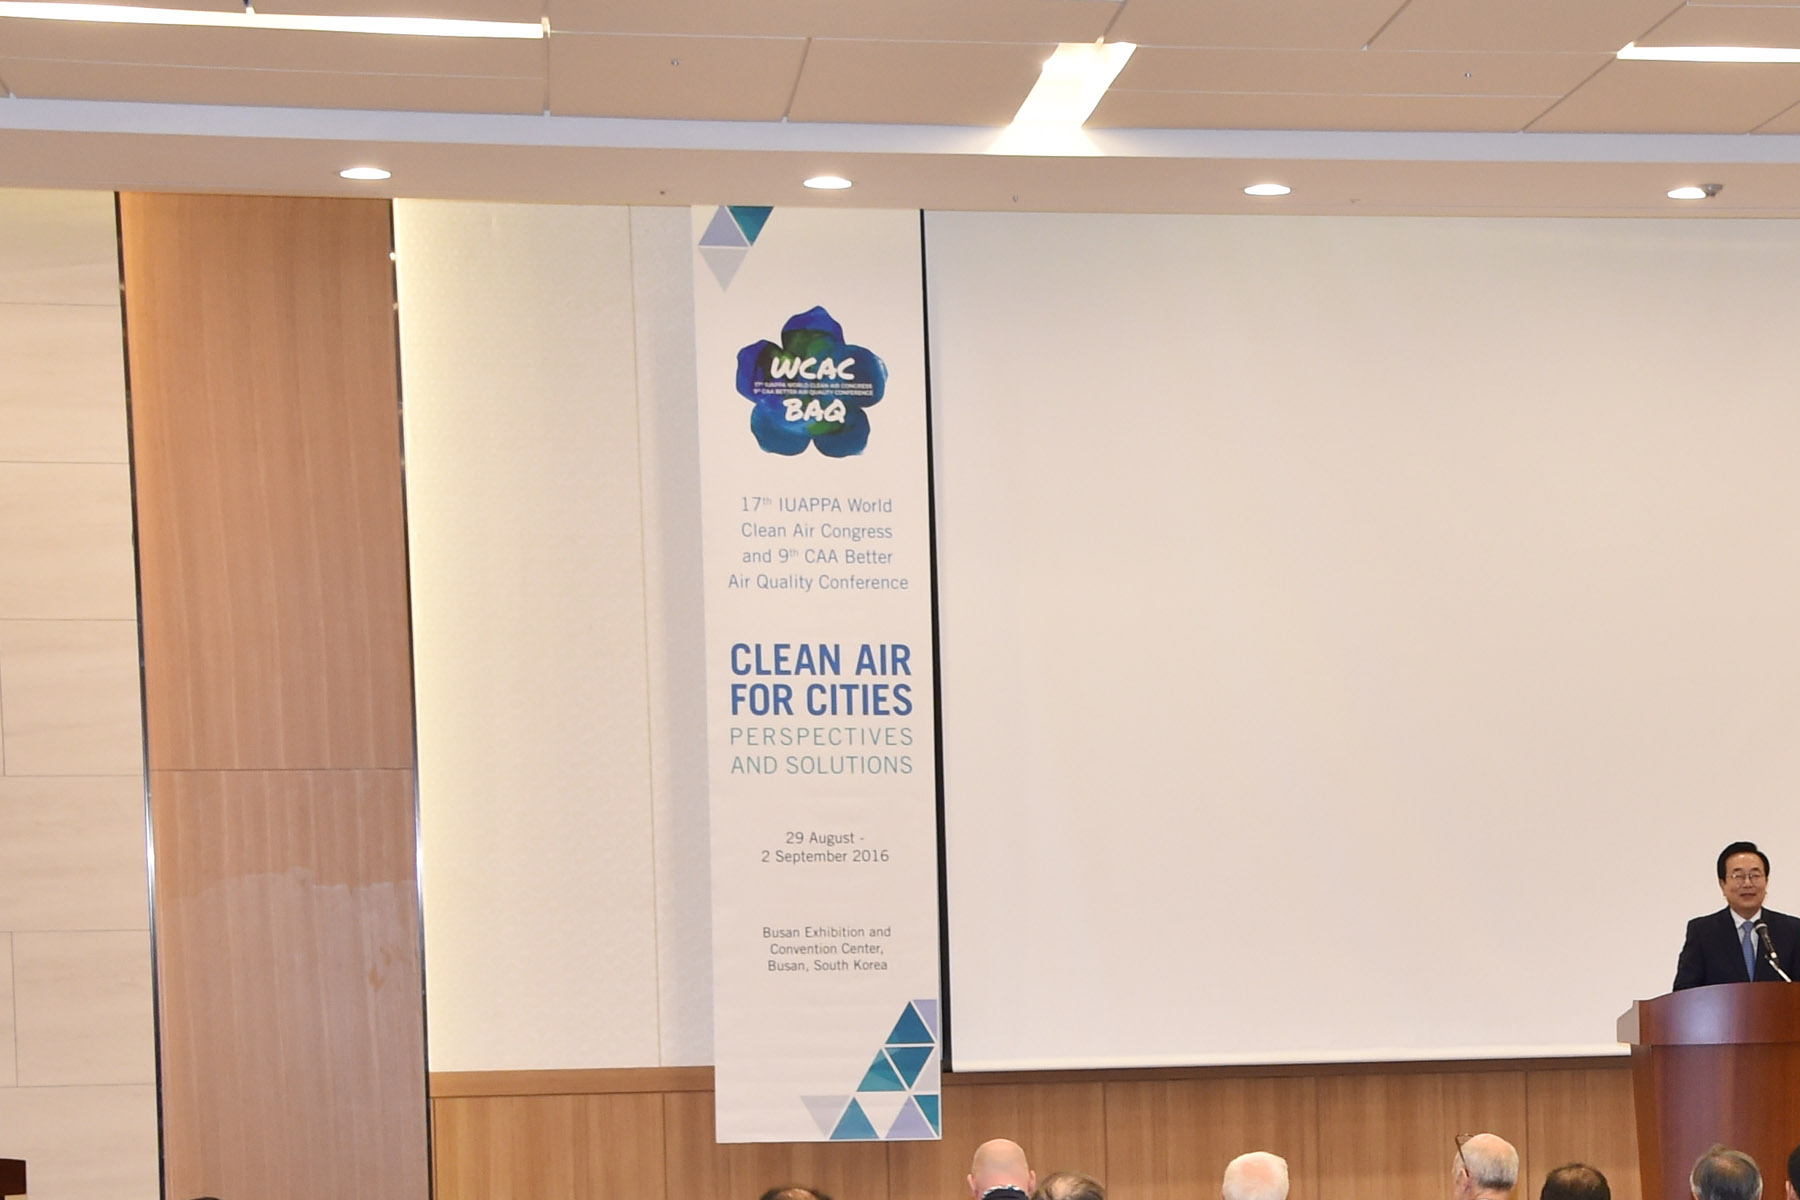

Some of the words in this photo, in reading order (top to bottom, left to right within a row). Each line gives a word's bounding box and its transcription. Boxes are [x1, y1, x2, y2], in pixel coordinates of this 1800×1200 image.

[770, 356, 855, 380] WCAC
[782, 398, 846, 423] BAQ
[779, 497, 842, 512] IUAPPA
[847, 498, 893, 513] World
[741, 522, 786, 538] Clean
[793, 523, 815, 538] Air
[820, 523, 893, 542] Congress
[742, 549, 772, 563] and
[804, 549, 838, 564] CAA
[845, 549, 893, 564] Better
[728, 574, 750, 589] Air
[756, 574, 813, 592] Quality
[818, 574, 909, 590] Conference
[731, 643, 841, 676] CLEAN
[855, 644, 912, 676] AIR
[731, 683, 794, 716] FOR
[806, 683, 913, 716] CITIES
[730, 727, 913, 746] PERSPECTIVES
[731, 756, 778, 774] AND
[786, 755, 913, 774] SOLUTIONS
[786, 831, 804, 844] 29
[809, 832, 855, 846] August
[761, 850, 770, 862] 2
[775, 850, 847, 865] September
[852, 850, 889, 862] 2016
[763, 927, 800, 938] Busan
[805, 926, 865, 938] Exhibition
[869, 927, 891, 937] and
[770, 943, 837, 955] Convention
[841, 943, 884, 955] Center,
[768, 960, 809, 972] Busan,
[814, 960, 849, 971] South
[854, 960, 888, 970] Korea
